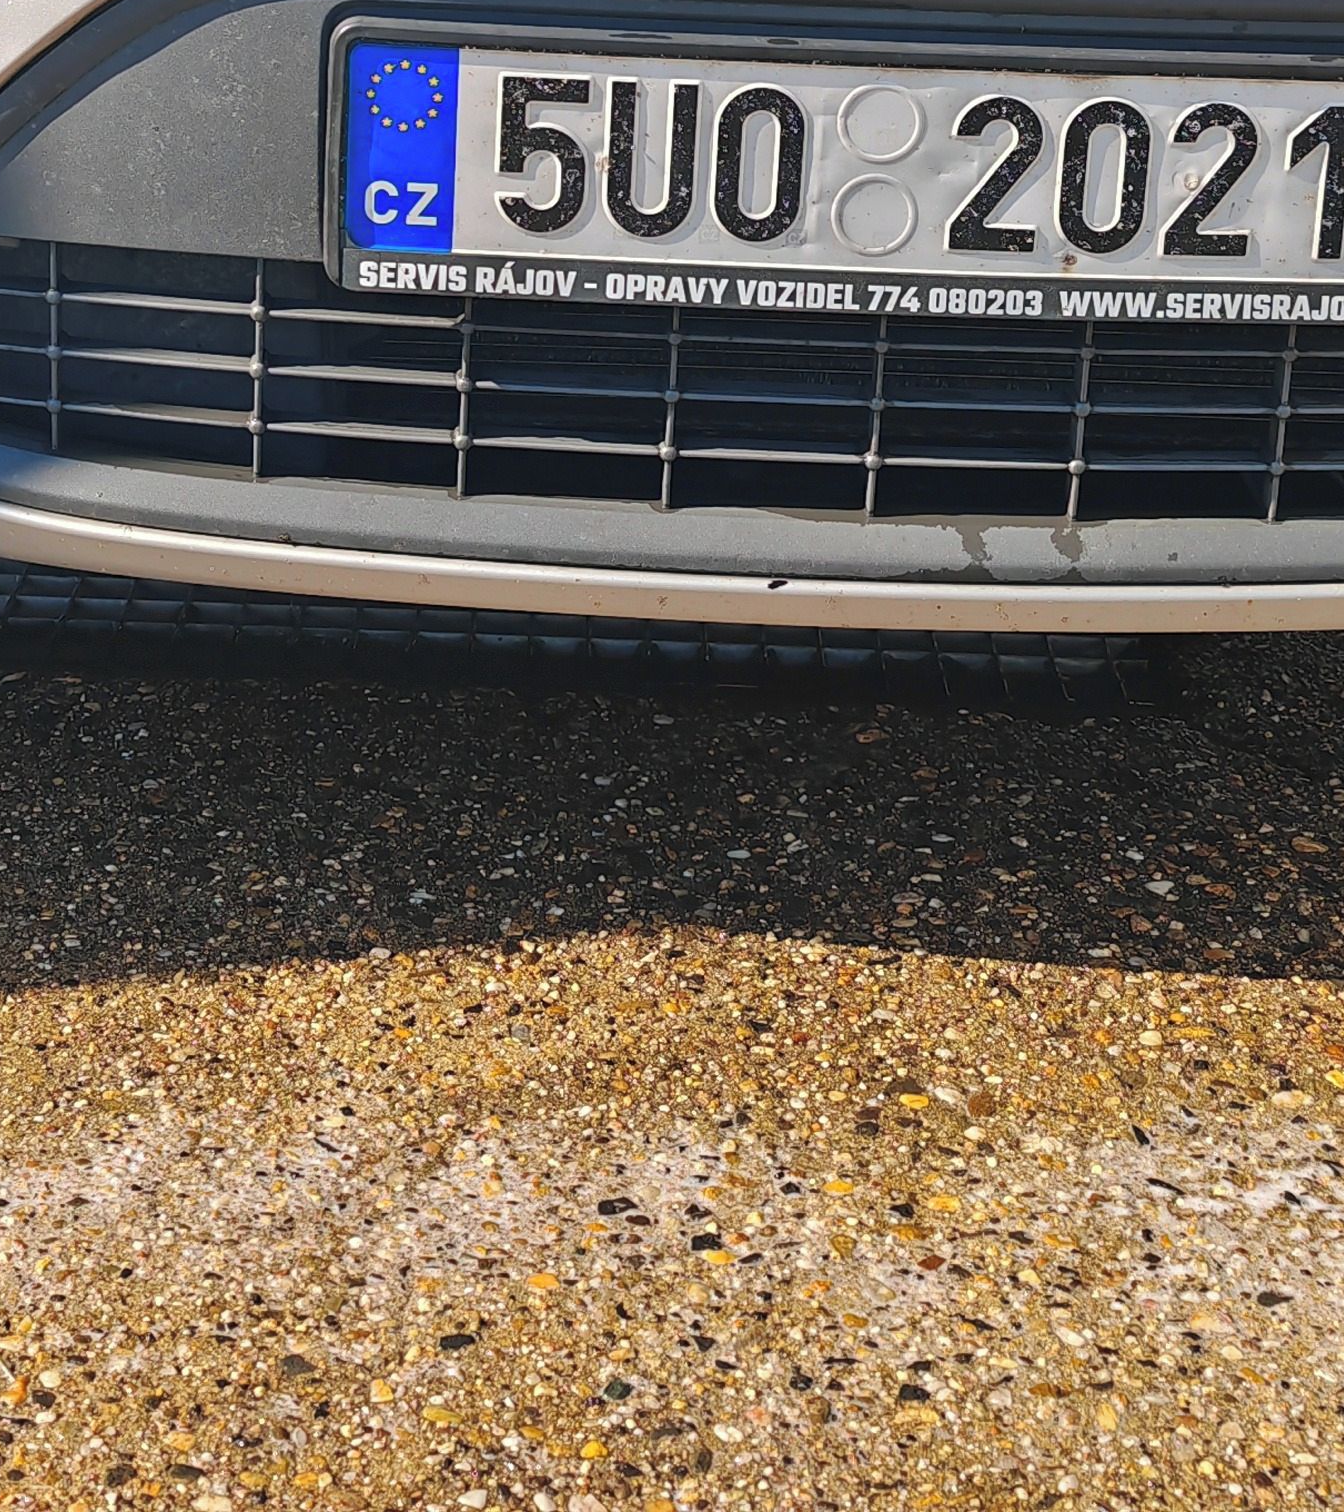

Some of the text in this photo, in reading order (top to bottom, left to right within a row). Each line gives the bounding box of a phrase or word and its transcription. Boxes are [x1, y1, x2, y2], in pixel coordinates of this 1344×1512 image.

[364, 180, 439, 227] CZ
[359, 261, 467, 292] SERVIS
[476, 261, 576, 299] RÁJOV
[606, 272, 728, 305] OPRAVY
[736, 279, 860, 313] VOZIDEL
[868, 286, 919, 314] 774
[929, 288, 1044, 318] 080203
